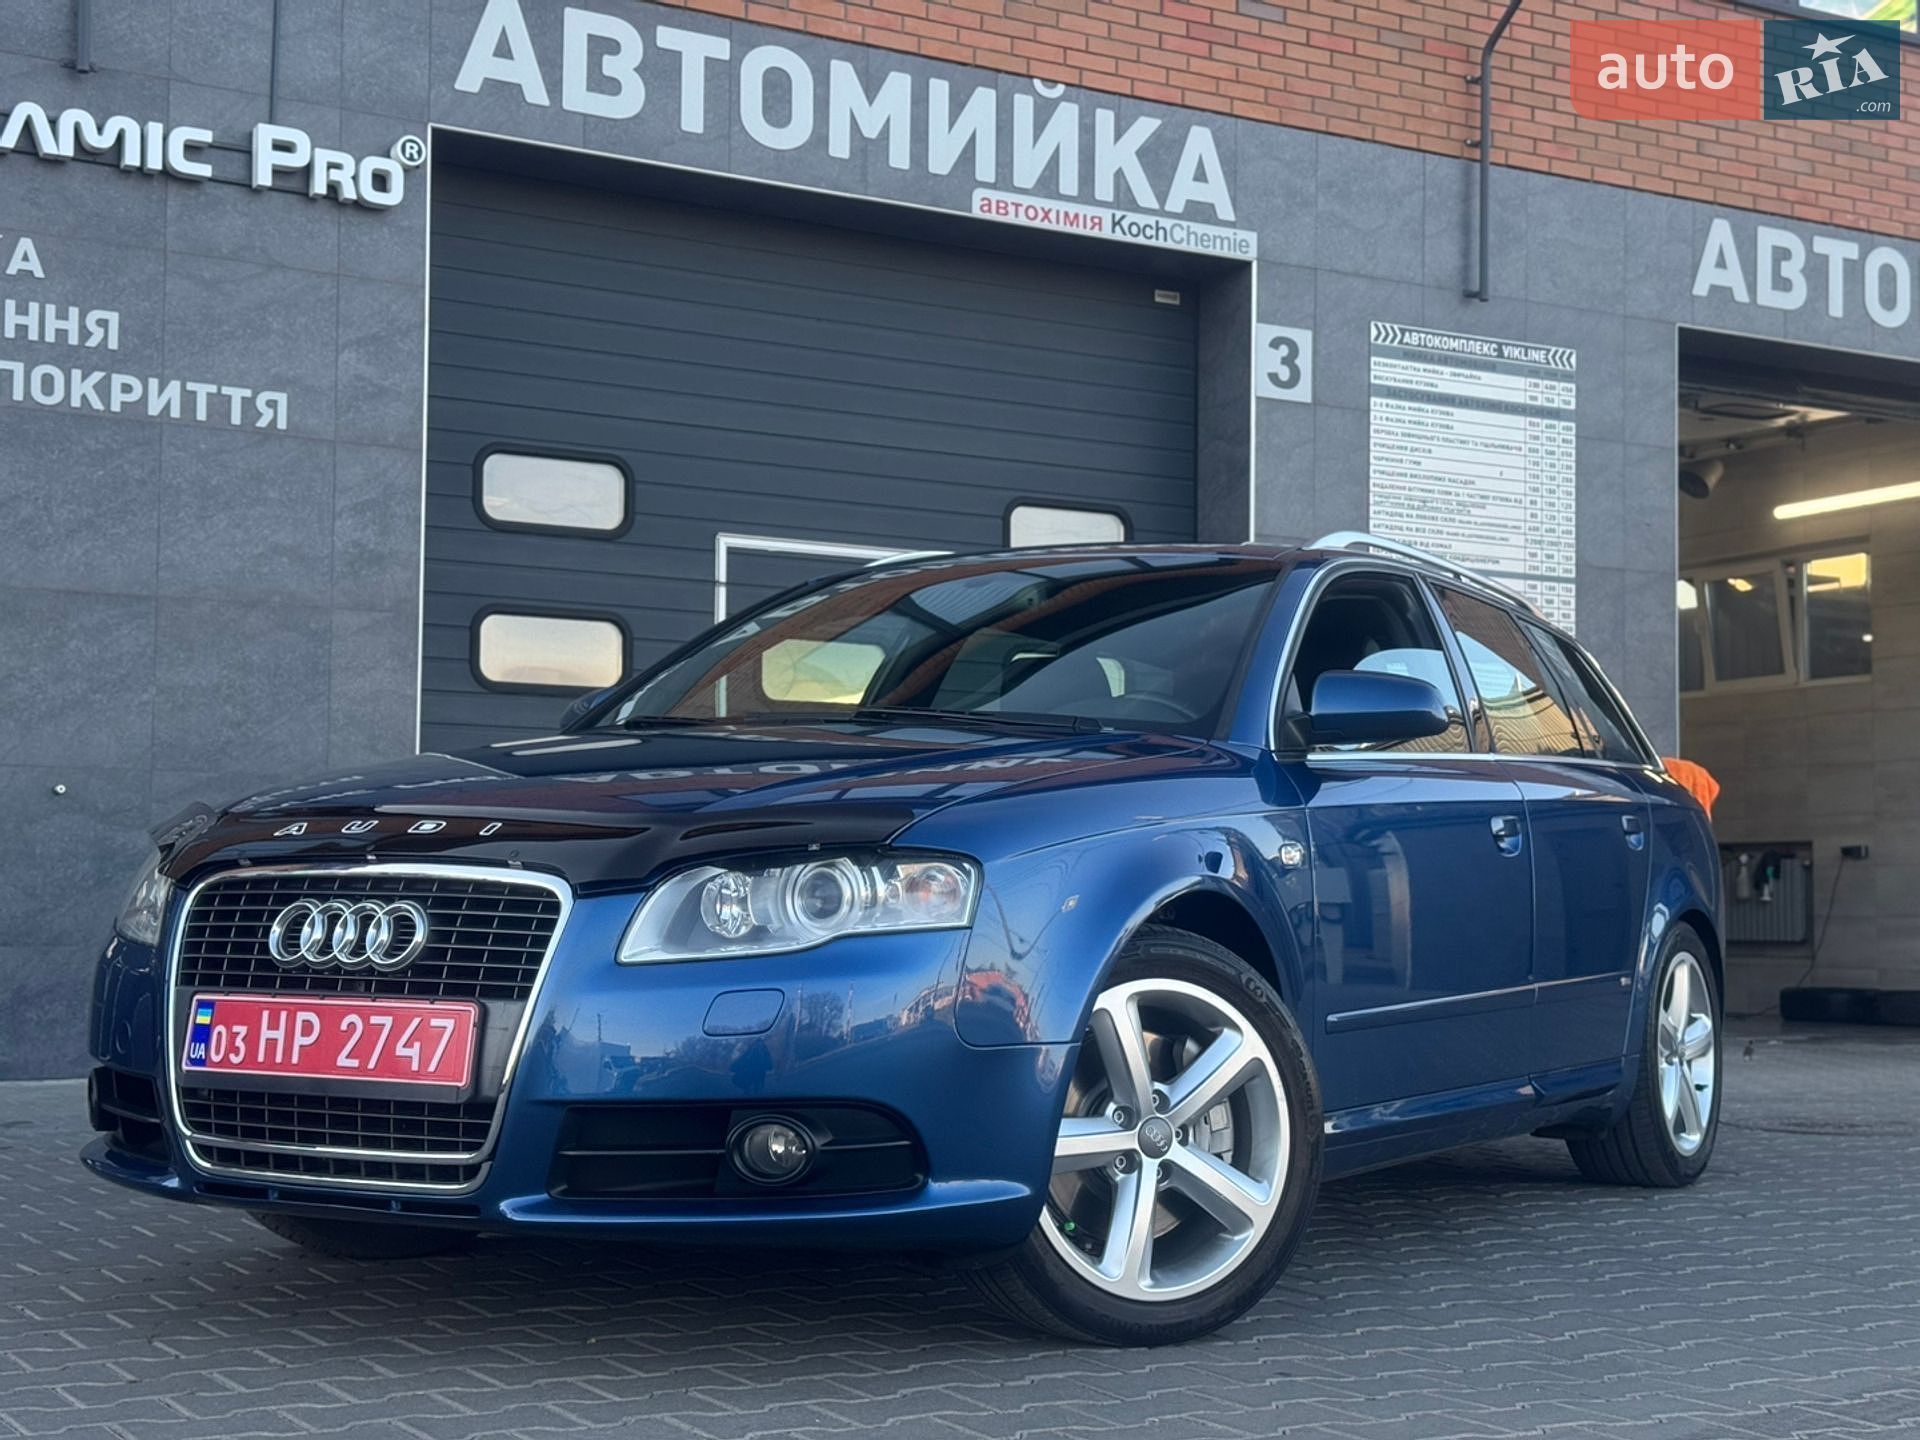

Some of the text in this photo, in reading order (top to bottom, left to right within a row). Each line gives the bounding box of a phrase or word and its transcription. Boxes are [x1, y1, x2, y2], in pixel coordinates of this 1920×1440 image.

[454, 0, 1236, 222] АВТОМИЙКА
[979, 196, 1103, 232] автохімія
[0, 234, 46, 279] А
[1691, 217, 1912, 329] АВТО
[4, 298, 120, 350] ННЯ
[1402, 330, 1499, 357] АВТОКОМПЛЕКС
[1502, 343, 1548, 364] VIKLINE
[1266, 335, 1301, 390] 3
[0, 359, 289, 430] ПОКРИТТЯ
[273, 820, 503, 836] AUDI
[189, 1041, 206, 1060] UA
[209, 1008, 456, 1074] 03 HP 2747
